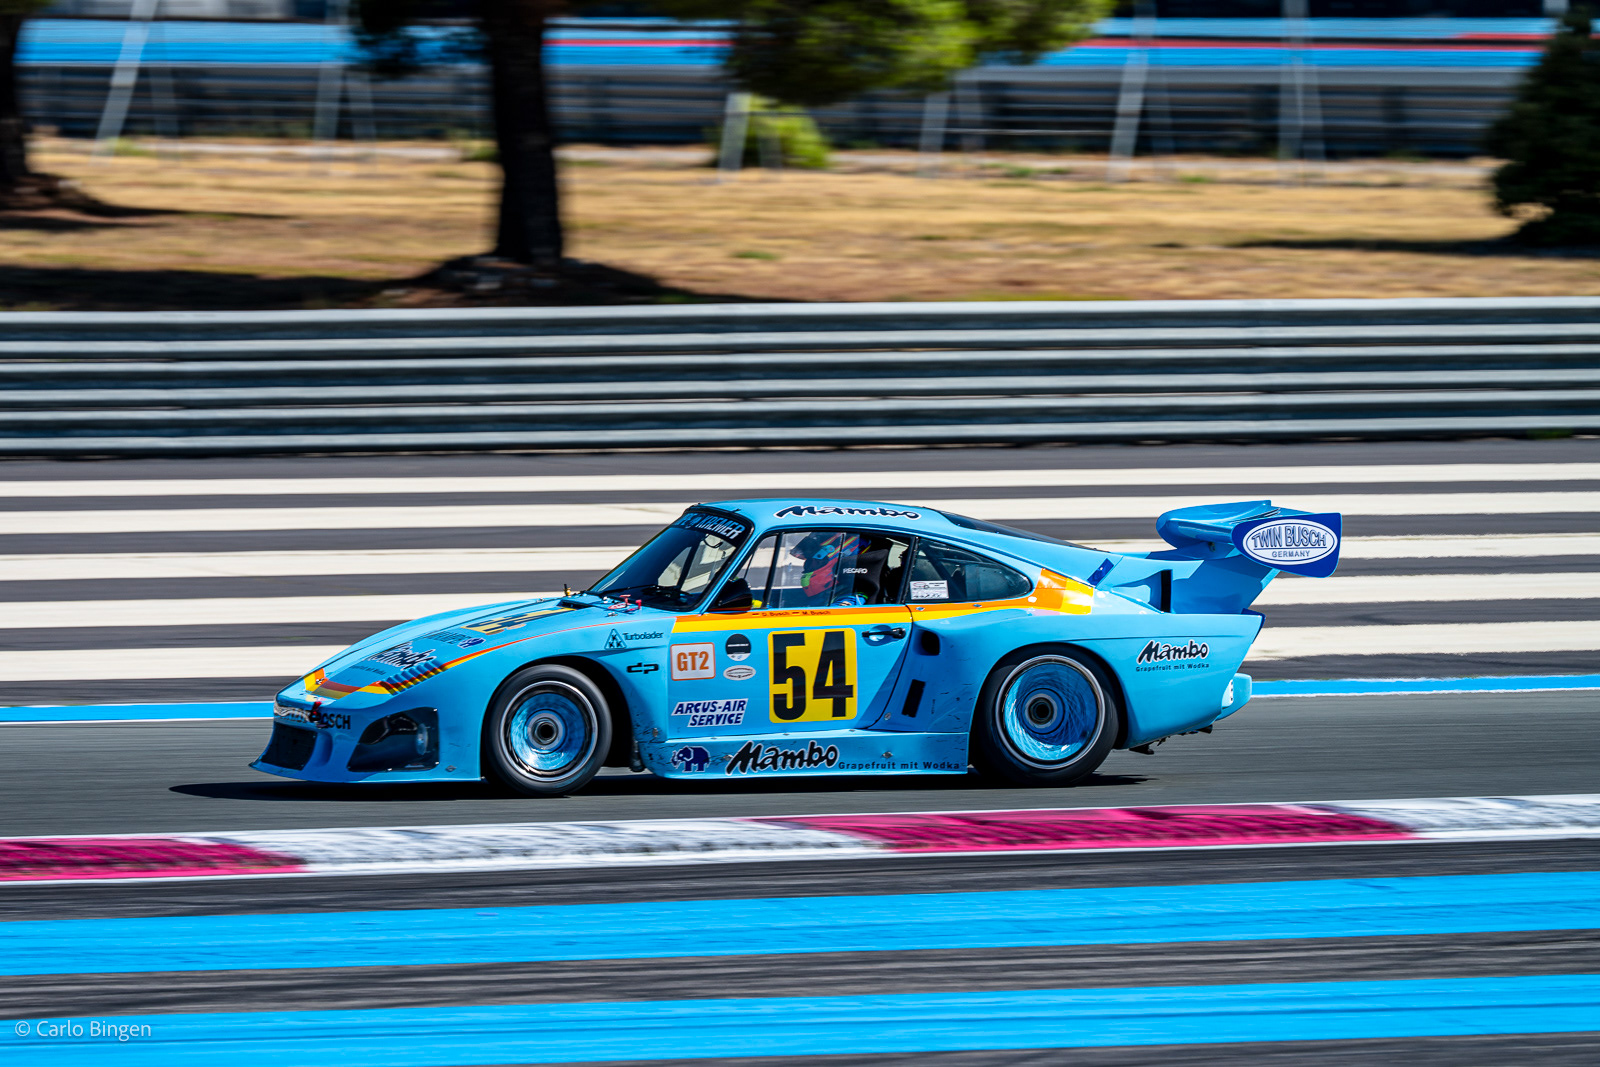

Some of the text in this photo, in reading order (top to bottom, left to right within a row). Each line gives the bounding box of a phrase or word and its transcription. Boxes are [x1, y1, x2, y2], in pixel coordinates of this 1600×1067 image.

[774, 505, 921, 520] Mambo
[695, 514, 746, 539] KREMER
[1251, 525, 1327, 548] TWIN BUSCH
[1271, 550, 1311, 558] GERMANY
[622, 631, 664, 640] Turbolader
[1136, 639, 1210, 665] Mambo
[676, 651, 709, 672] GT2
[772, 631, 854, 720] 54
[674, 700, 747, 715] ARCUS-AIR
[689, 713, 744, 726] SERVICE
[725, 740, 840, 775] Mambo
[838, 761, 960, 770] Grapefruit mit Wodka
